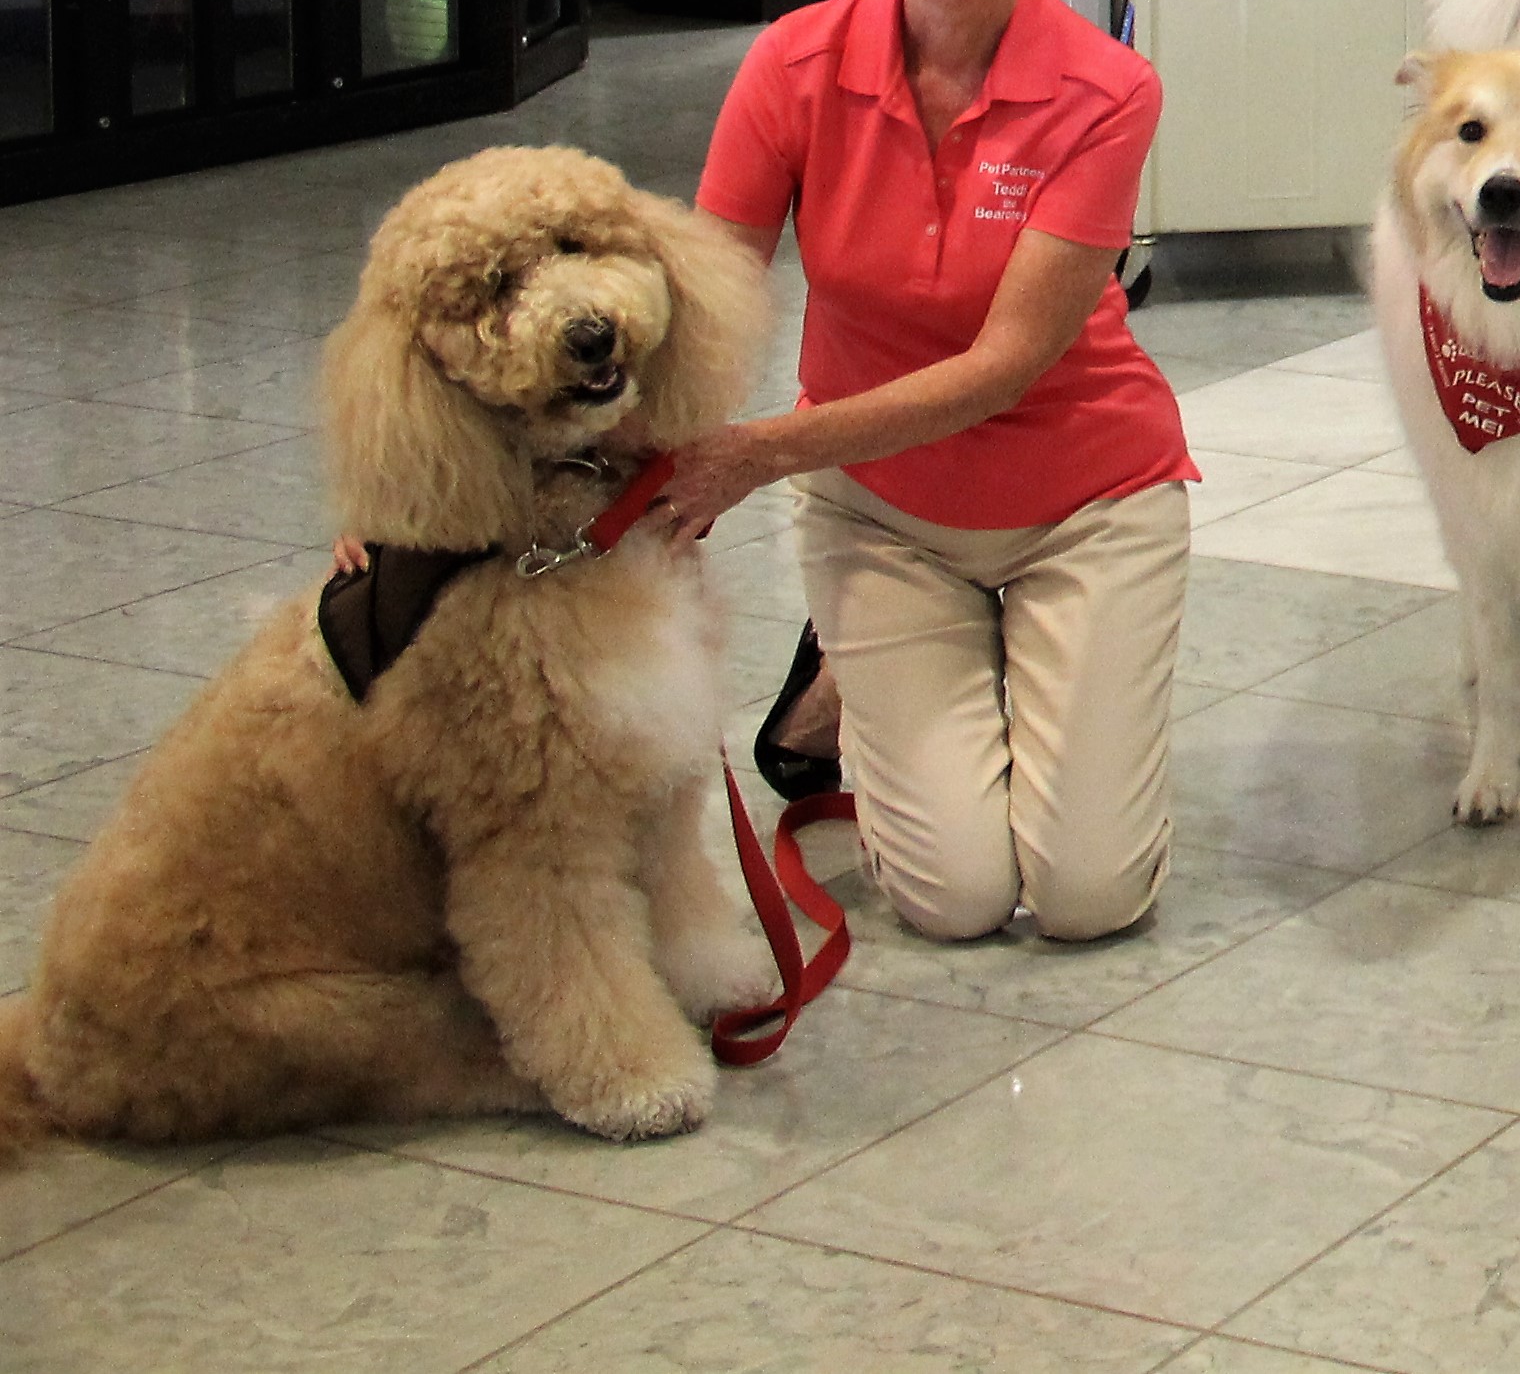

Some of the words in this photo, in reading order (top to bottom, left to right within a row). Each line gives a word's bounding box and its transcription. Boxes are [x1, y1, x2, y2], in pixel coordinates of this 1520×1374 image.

[978, 161, 1000, 175] Pet
[1461, 392, 1511, 417] PET
[1458, 410, 1505, 438] ME!
